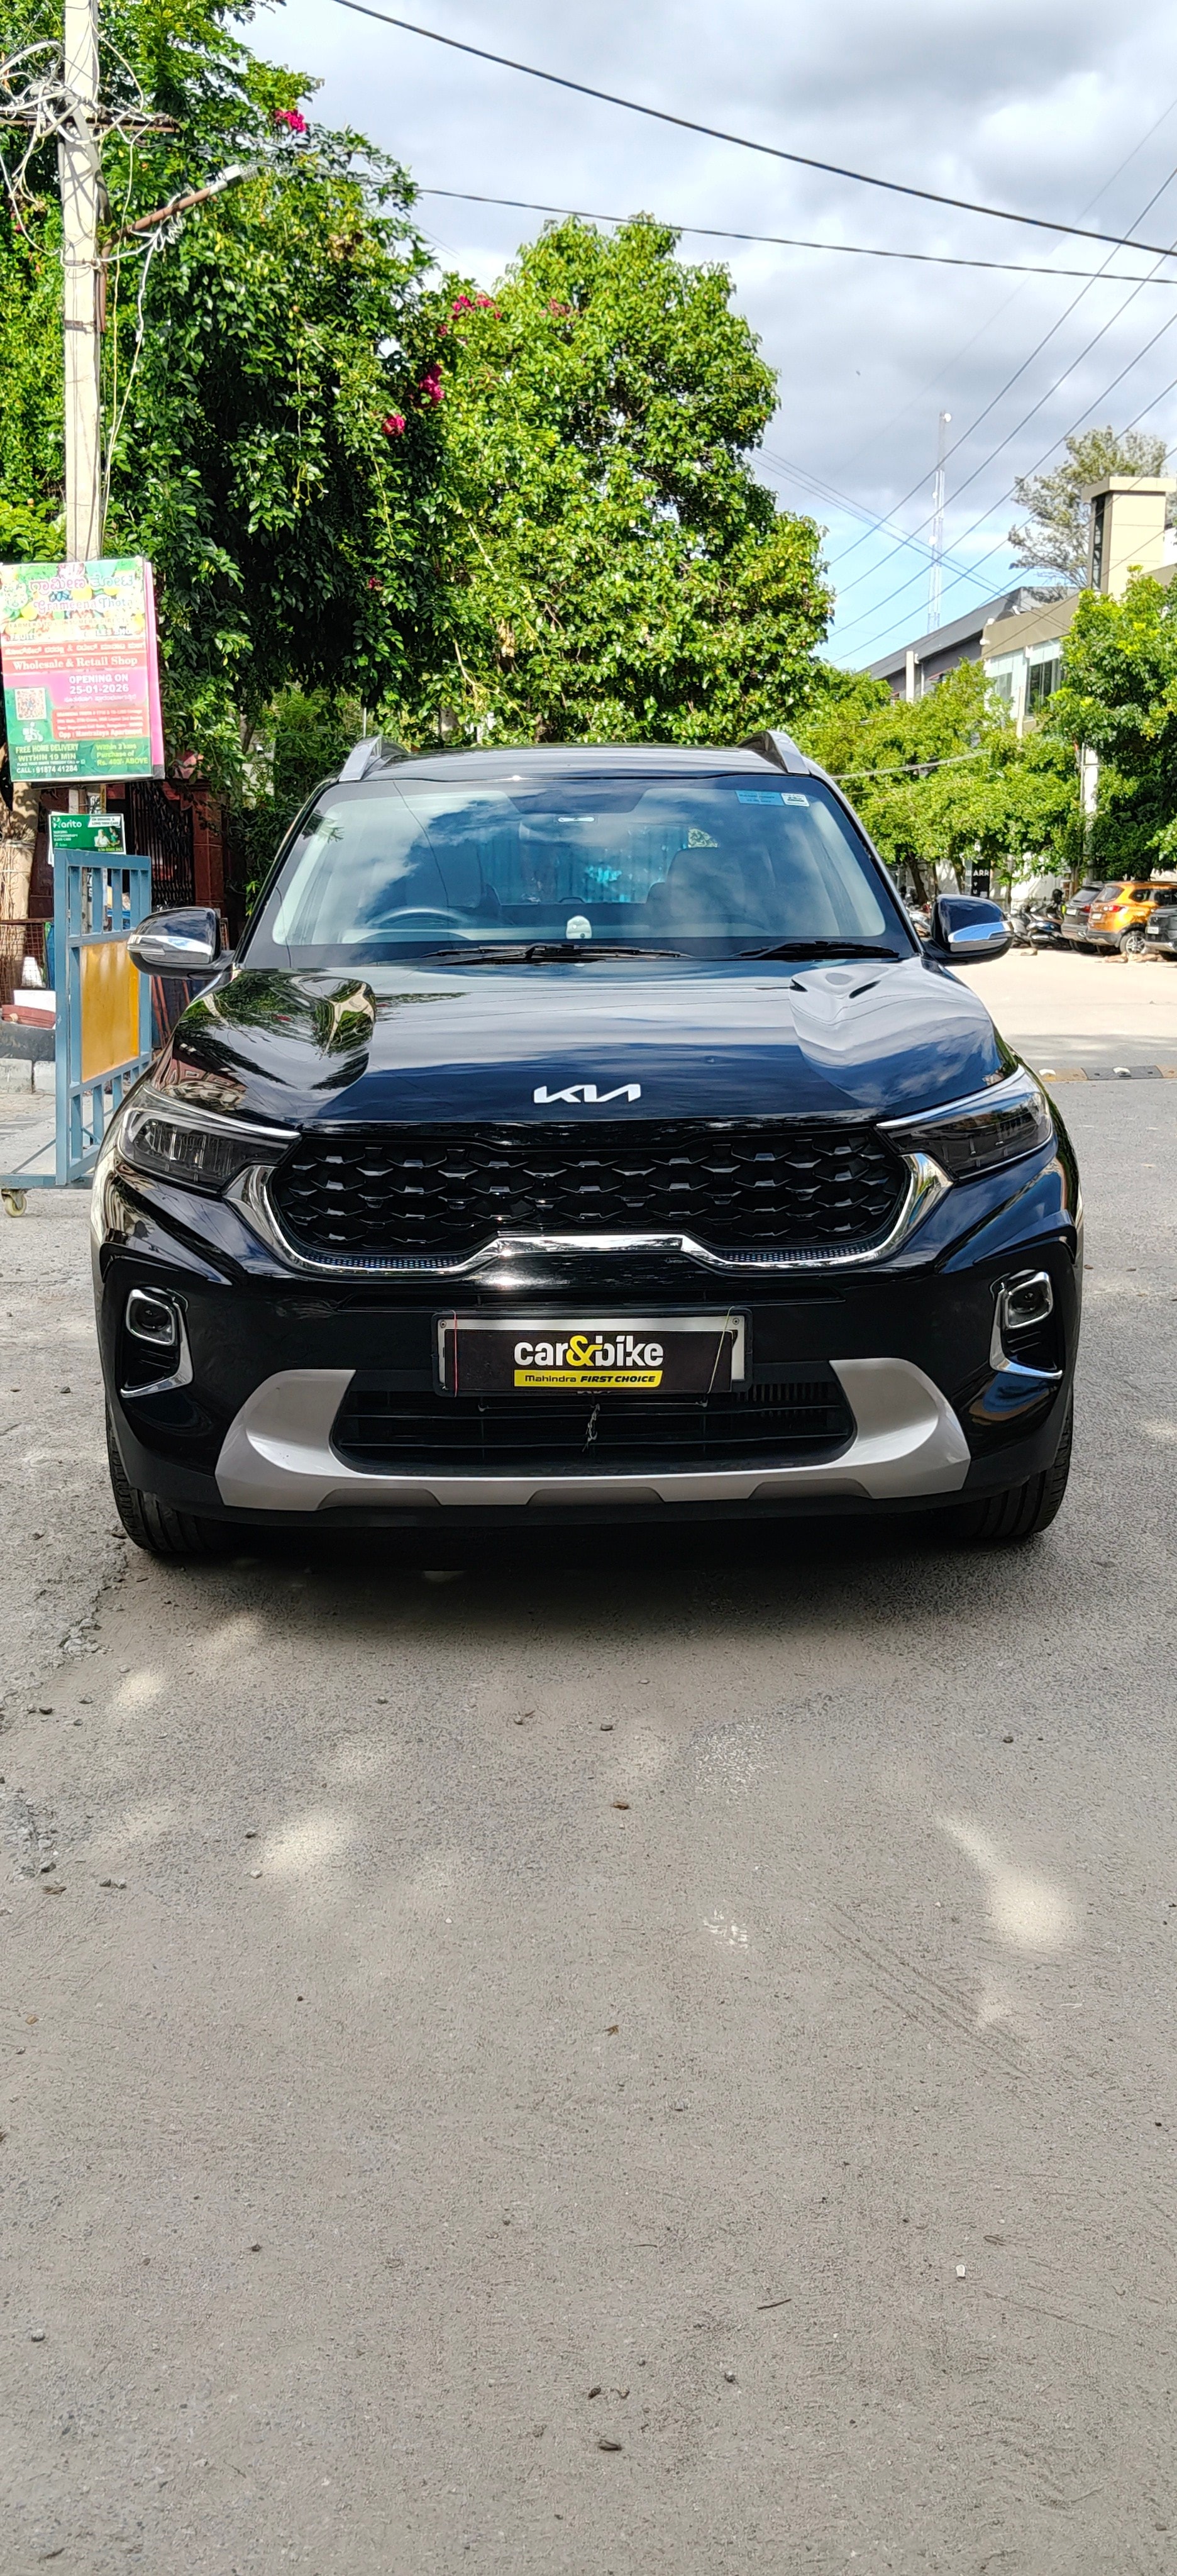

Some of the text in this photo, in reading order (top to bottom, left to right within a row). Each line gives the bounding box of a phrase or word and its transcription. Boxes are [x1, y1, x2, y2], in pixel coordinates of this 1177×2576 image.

[33, 597, 133, 614] Grameena Thota
[13, 655, 138, 670] Wholesale & Retail Shop
[69, 674, 128, 684] OPENING ON
[70, 684, 129, 694] 25-01-2026
[50, 743, 79, 752] DELIVERY
[514, 1335, 664, 1367] car&bike
